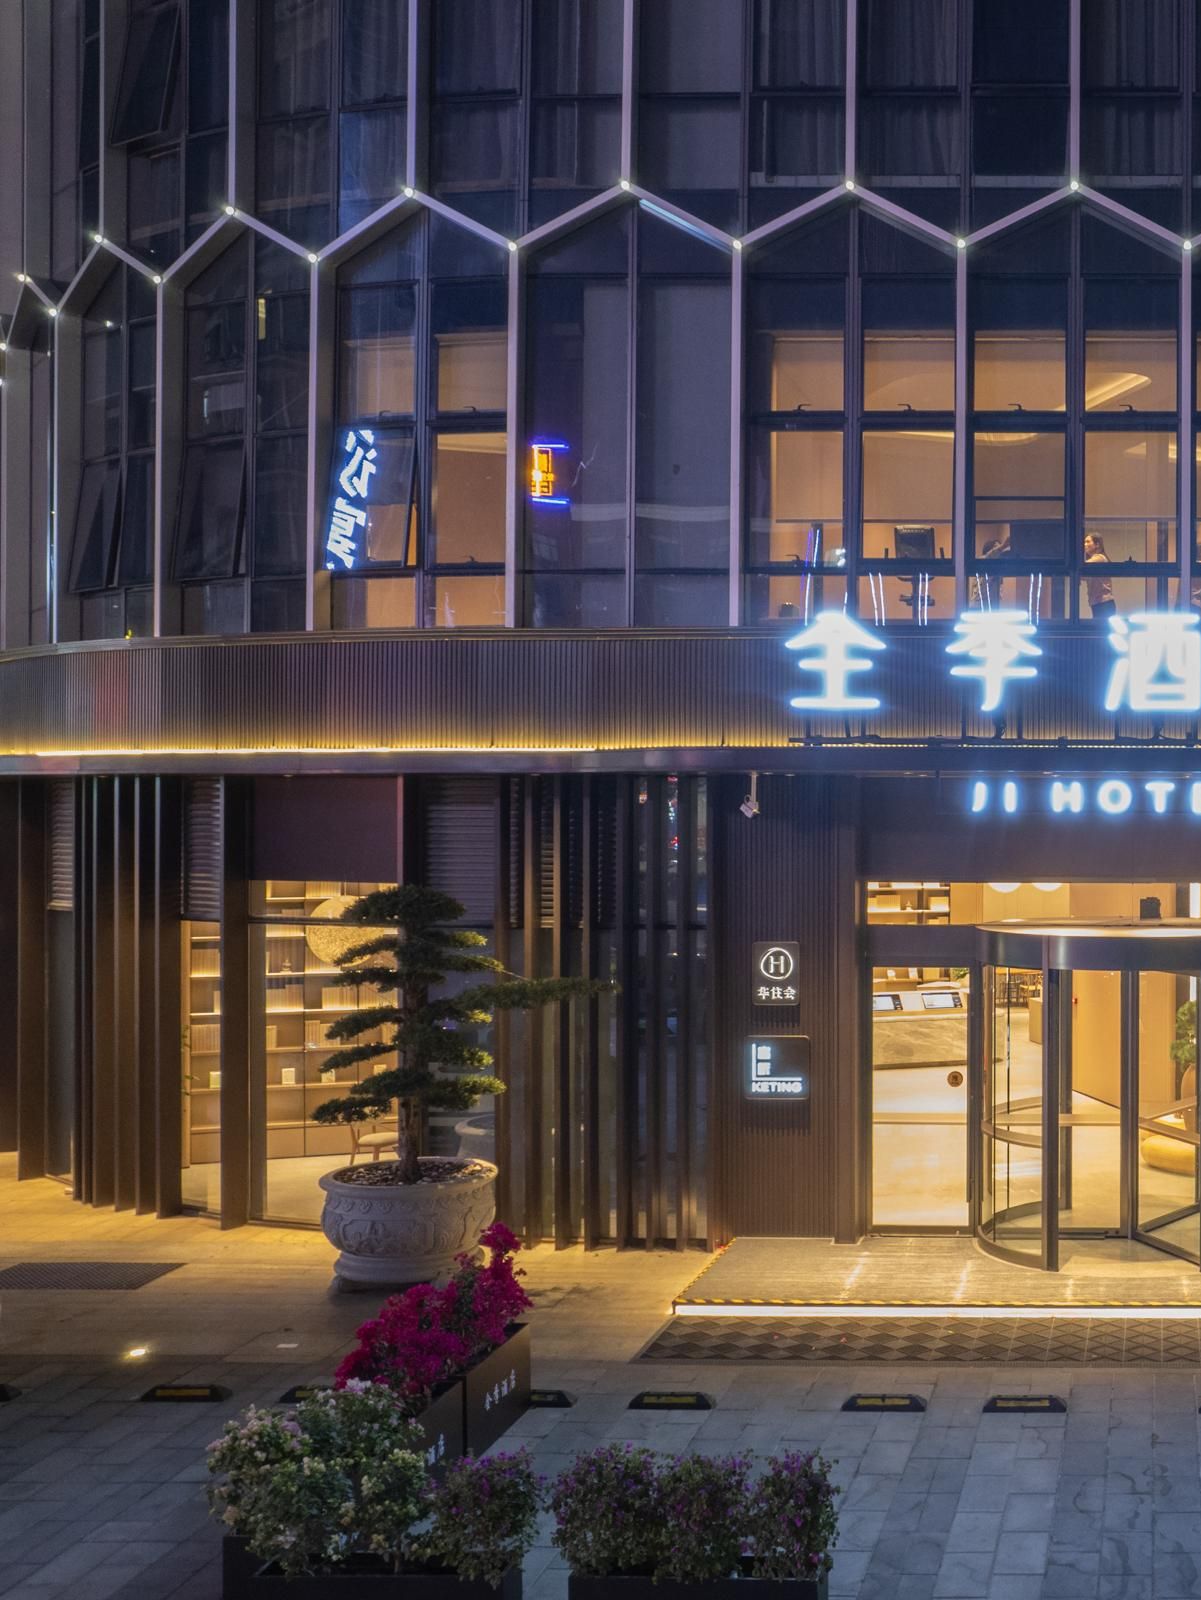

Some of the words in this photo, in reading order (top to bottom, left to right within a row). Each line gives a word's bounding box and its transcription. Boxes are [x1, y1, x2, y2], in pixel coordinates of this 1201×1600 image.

[971, 781, 1017, 813] JI
[757, 986, 796, 1000] 华住会
[751, 1082, 803, 1093] KETING
